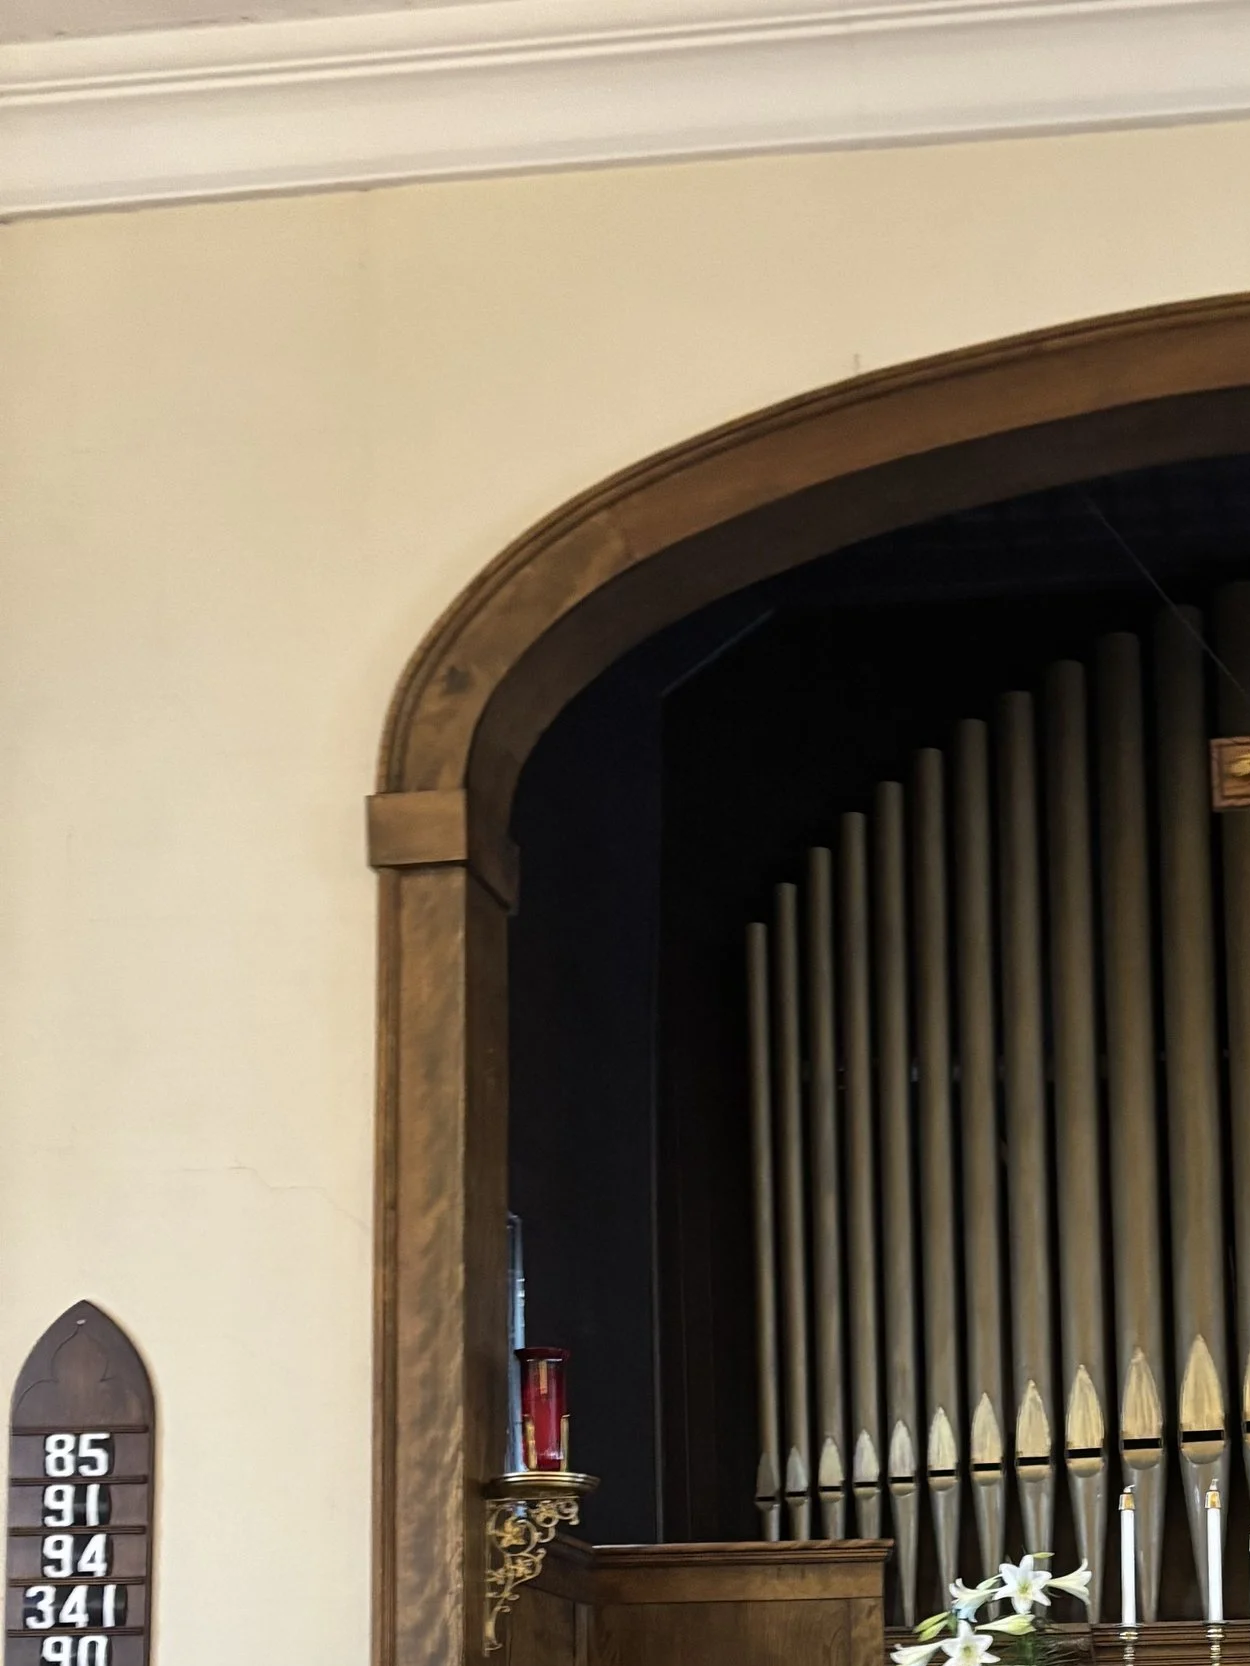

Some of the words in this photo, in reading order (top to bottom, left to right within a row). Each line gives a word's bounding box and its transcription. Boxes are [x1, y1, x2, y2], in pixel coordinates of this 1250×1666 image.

[44, 1433, 111, 1478] 85
[43, 1483, 101, 1528] 91
[42, 1533, 109, 1579] 94
[25, 1585, 117, 1629] 341
